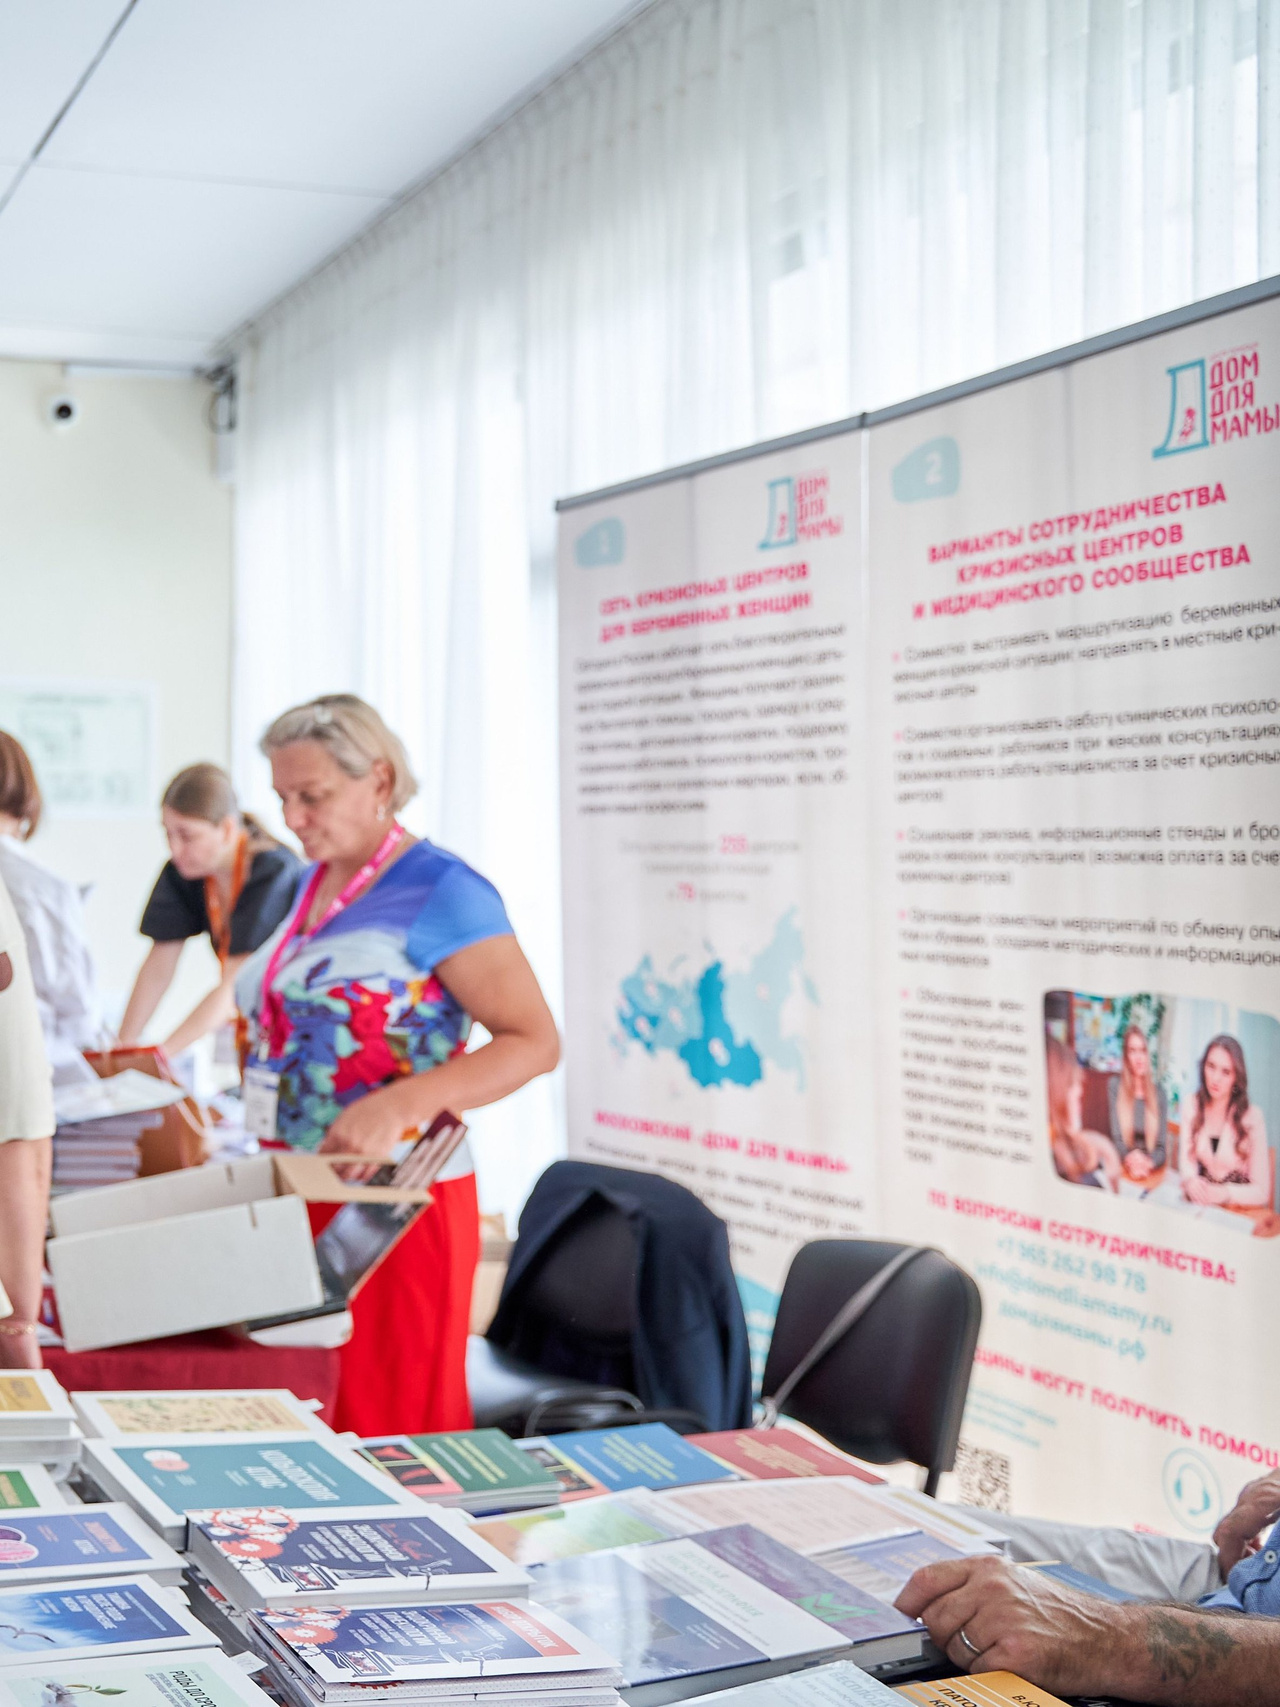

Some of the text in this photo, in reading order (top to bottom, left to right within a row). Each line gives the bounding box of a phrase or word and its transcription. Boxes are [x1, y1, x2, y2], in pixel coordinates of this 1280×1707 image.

[1208, 347, 1260, 390] ДОМ
[1209, 381, 1254, 418] ДЛЯ
[1209, 404, 1280, 444] МАМЫ
[925, 453, 942, 485] 2
[797, 475, 830, 499] ДОМ
[927, 482, 1227, 564] ВАРИАНТЫ СОТРУДНИЧЕСТВА
[956, 524, 1184, 585] КРИЗИСНЫХ ЦЕНТРОВ
[636, 577, 727, 612] КРИЗИСНЫХ
[733, 561, 810, 592] ЦЕНТРОВ
[912, 542, 1251, 621] И МЕДИЦИНСКОГО СООБЩЕСТВА
[631, 605, 731, 637] БЕРЕМЕННЫХ
[737, 592, 813, 621] ЖЕНЩИН
[1181, 592, 1280, 624] беременных
[1173, 627, 1243, 649] местные
[1117, 704, 1207, 726] клинических
[1161, 753, 1196, 770] счет
[1167, 825, 1226, 843] стенды
[1232, 827, 1243, 840] и
[1169, 851, 1224, 867] оплата
[1228, 851, 1247, 867] за
[1160, 922, 1179, 938] по
[1182, 918, 1245, 942] обмену
[953, 1198, 1044, 1234] ВОПРОСАМ
[1048, 1220, 1238, 1284] СОТРУДНИЧЕСТВА:
[1123, 1267, 1148, 1294] 78
[1029, 1363, 1087, 1402] МОГУТ
[1090, 1387, 1195, 1439] ПОЛУЧИТЬ
[169, 1670, 198, 1688] РОДЫ
[183, 1687, 206, 1697] ДО
